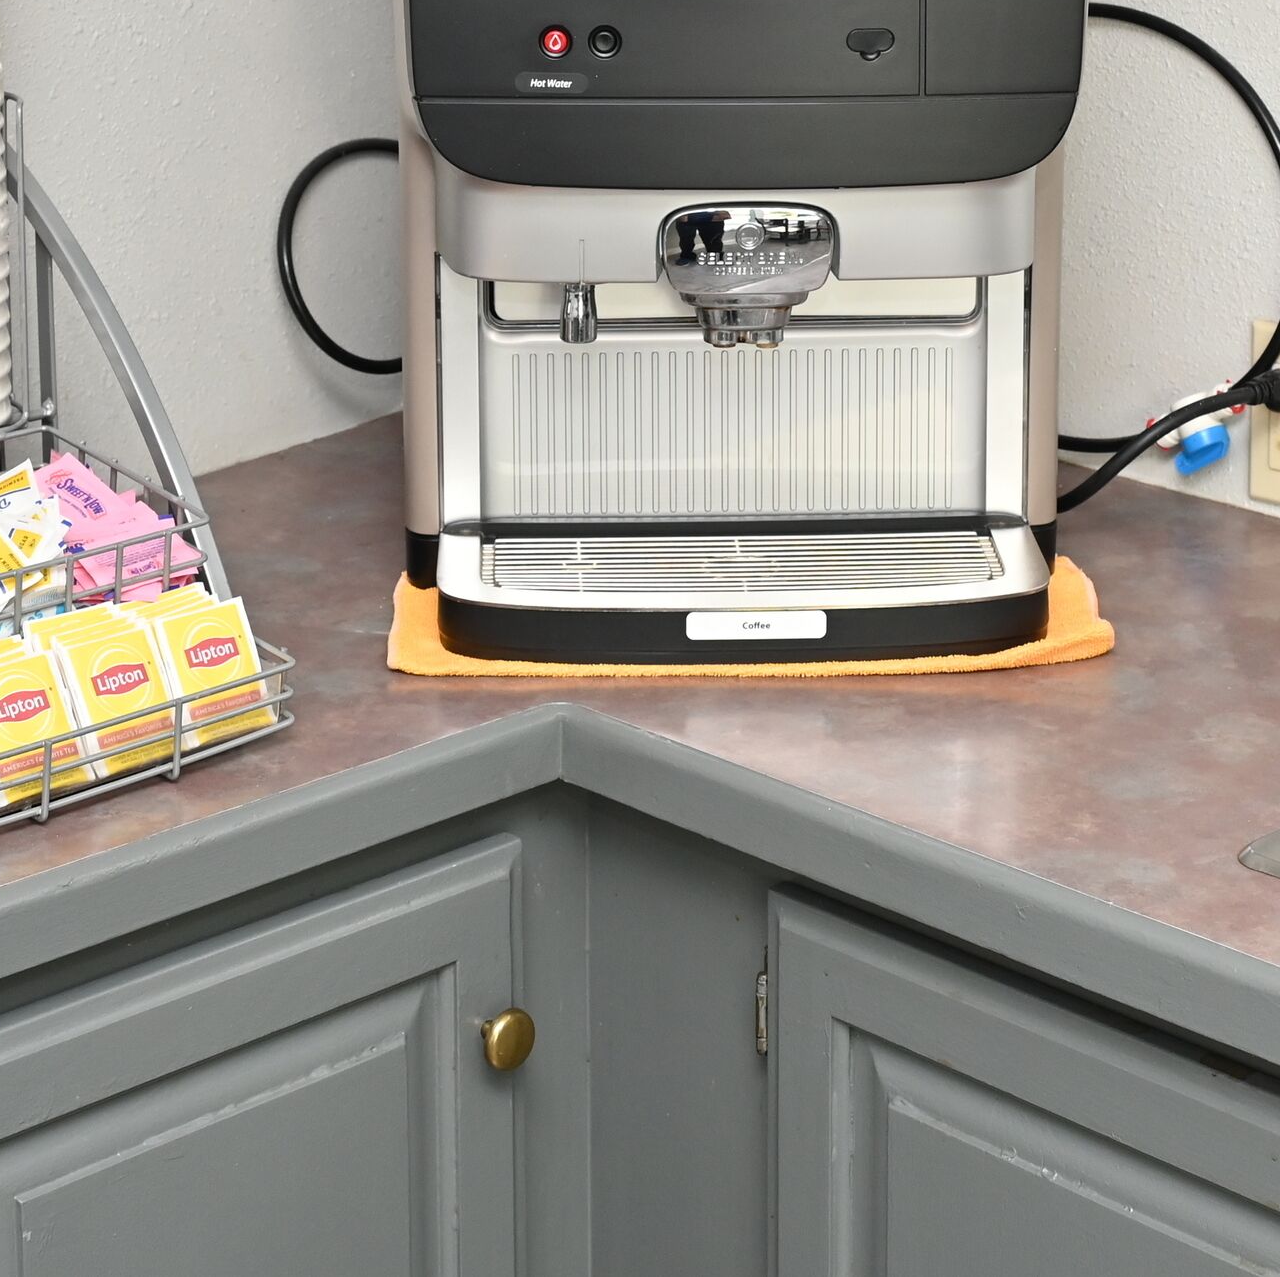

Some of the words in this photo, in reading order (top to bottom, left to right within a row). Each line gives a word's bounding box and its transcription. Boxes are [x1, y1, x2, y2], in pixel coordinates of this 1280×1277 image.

[530, 79, 546, 87] Hot
[547, 79, 572, 88] Water
[742, 621, 771, 630] Coffee
[190, 643, 234, 663] Lipton
[96, 669, 144, 691] Lipton
[2, 759, 35, 773] AMERICA'S
